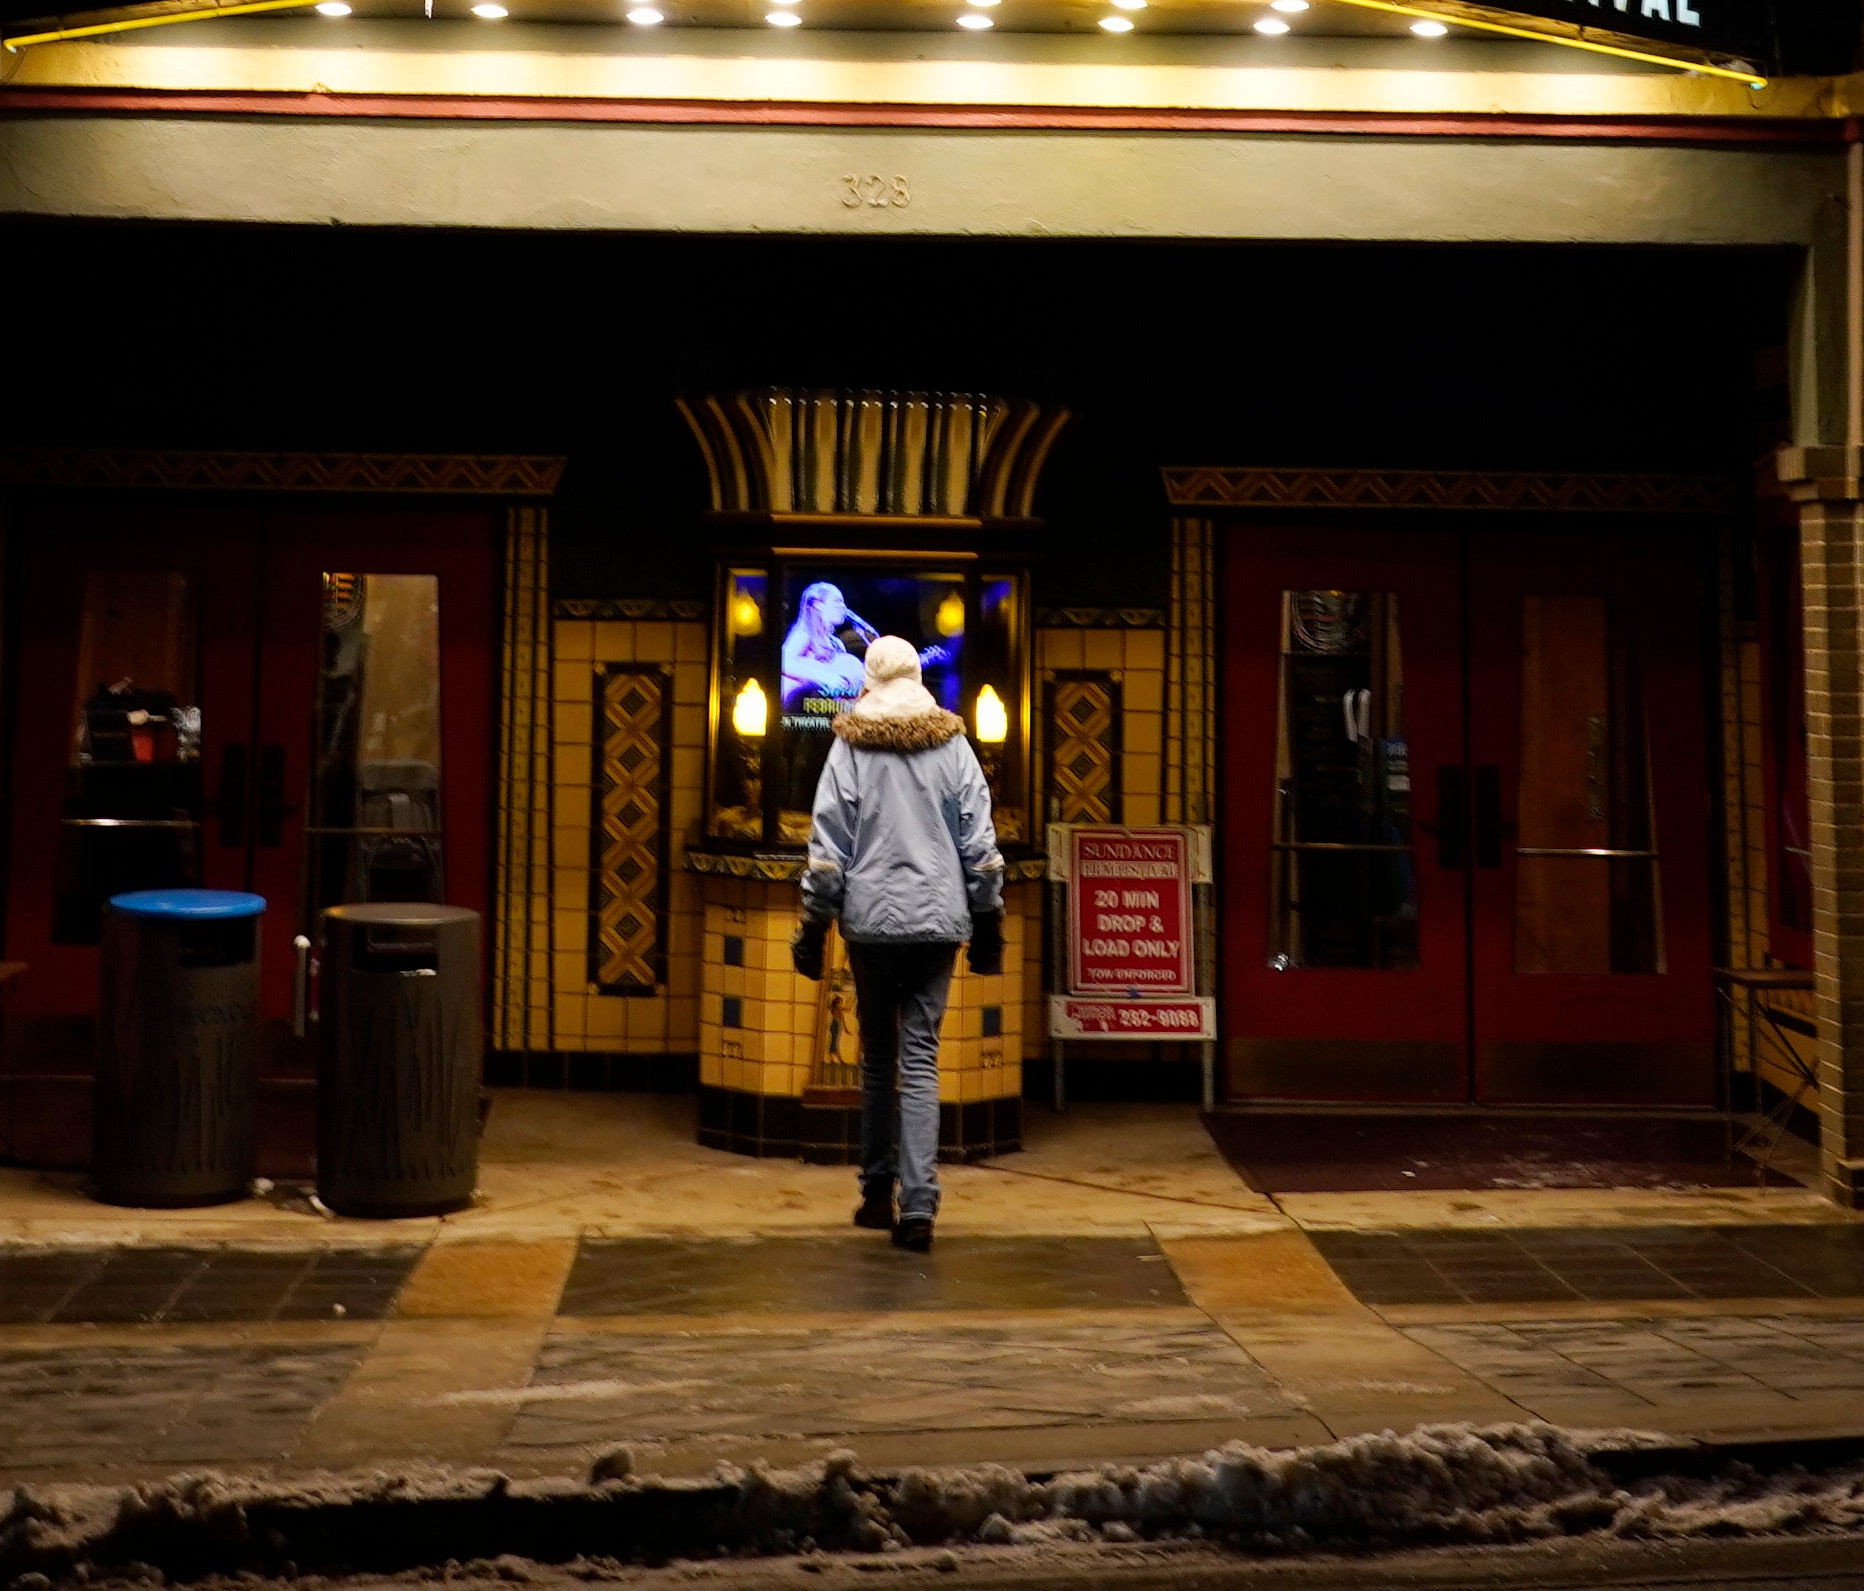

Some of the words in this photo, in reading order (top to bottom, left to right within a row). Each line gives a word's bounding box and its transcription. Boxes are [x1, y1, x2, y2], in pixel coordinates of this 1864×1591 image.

[840, 174, 911, 209] 328
[1082, 841, 1177, 860] SUNDANCE
[1094, 889, 1119, 909] 20
[1121, 889, 1160, 909] MIN
[1097, 913, 1147, 933] DROP
[1148, 915, 1165, 934] &
[1081, 938, 1130, 958] LOAD
[1131, 939, 1181, 959] ONLY
